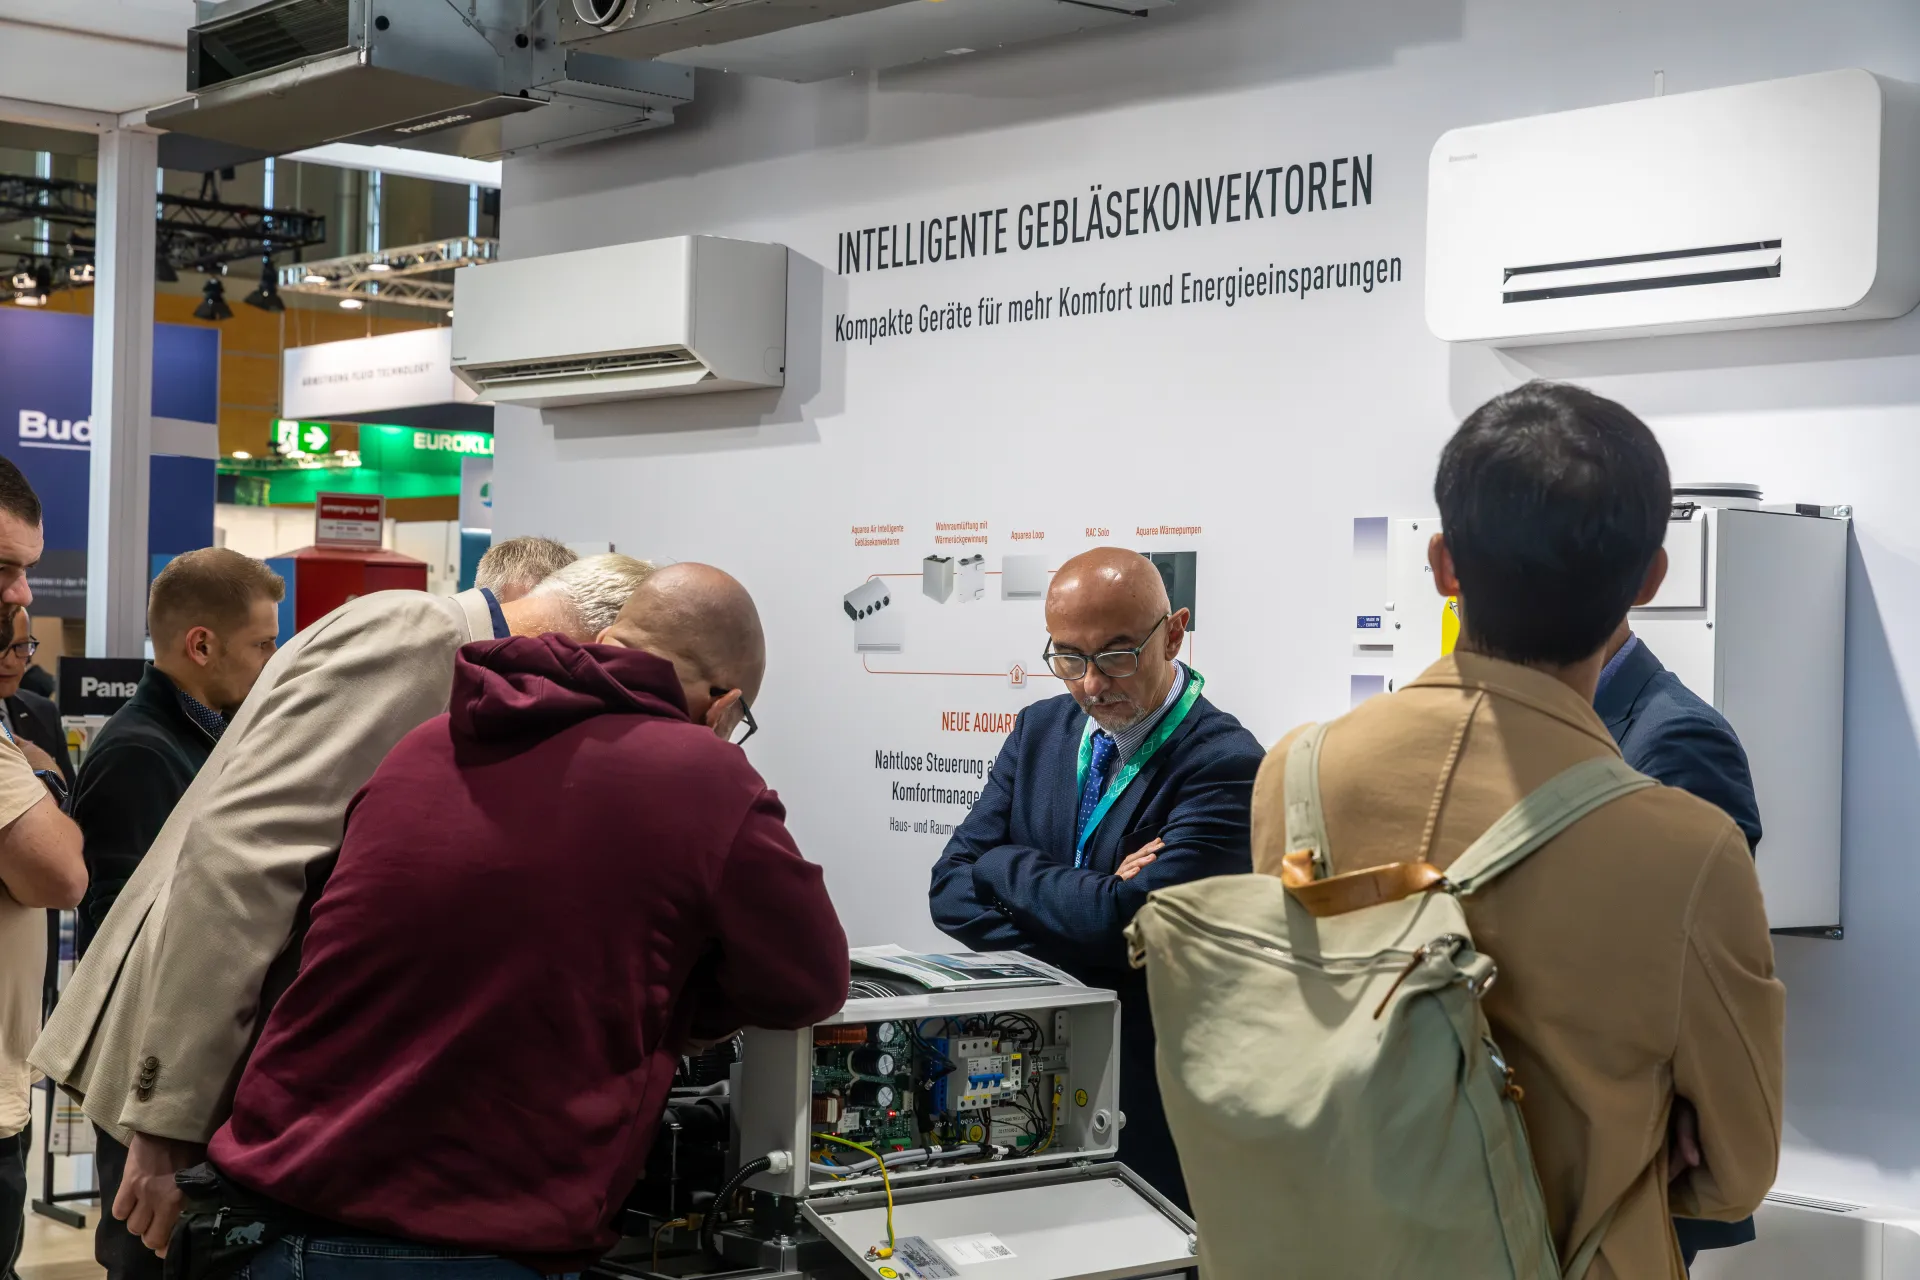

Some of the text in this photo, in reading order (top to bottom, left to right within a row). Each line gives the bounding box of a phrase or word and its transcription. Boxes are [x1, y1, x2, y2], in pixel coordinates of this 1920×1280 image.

[837, 153, 1374, 275] INTELLIGENTE GEBLÄSEKONVEKTOREN
[835, 256, 1402, 345] Kompakte Geräte für mehr Komfort und Energieeinsparungen
[851, 525, 870, 535] Aquarea
[877, 524, 904, 535] Intelligente
[935, 521, 988, 532] Wohnraumlüftung mit
[1010, 529, 1045, 541] Aquarea Loop
[1085, 527, 1110, 537] RAC Solo
[1136, 525, 1202, 537] Aquarea Wärmepumpen
[81, 676, 138, 697] Pana
[941, 711, 971, 732] NEUE
[875, 749, 923, 772] Nahtlose
[926, 752, 983, 779] Steuerung
[889, 816, 912, 833] Haus-
[913, 818, 928, 834] und
